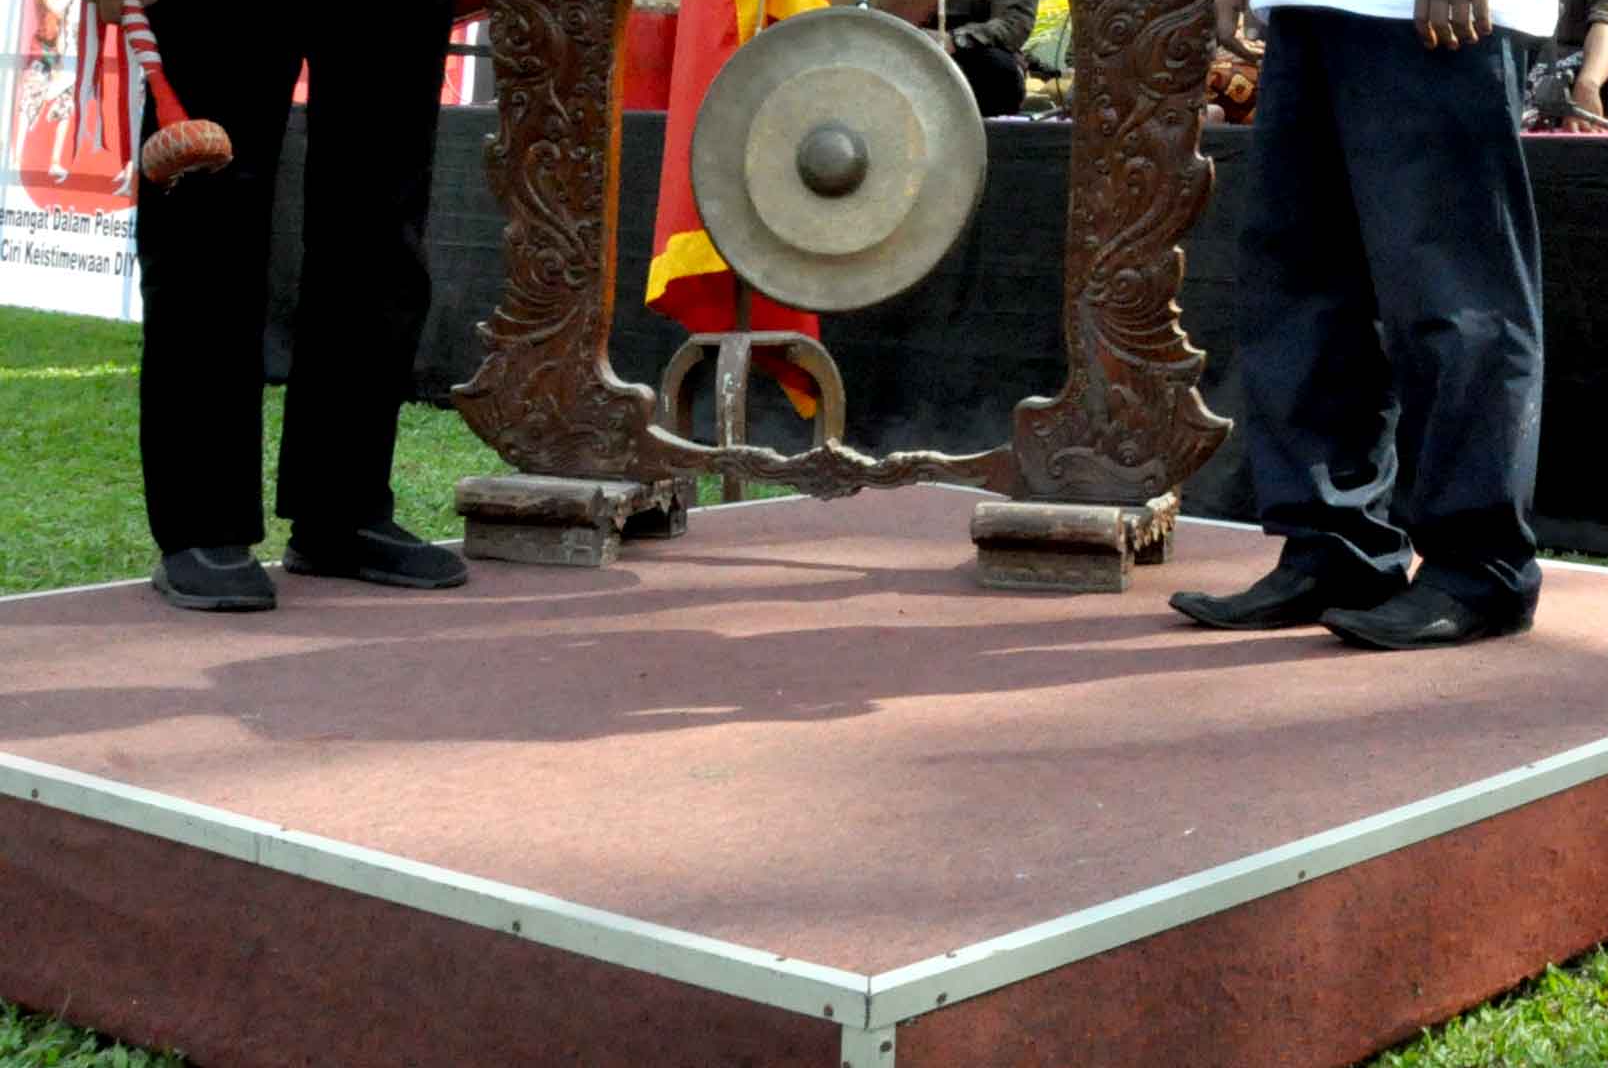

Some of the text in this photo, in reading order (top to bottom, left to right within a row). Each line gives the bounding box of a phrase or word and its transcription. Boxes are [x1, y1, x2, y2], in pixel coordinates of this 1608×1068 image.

[53, 206, 91, 235] Dalam
[1, 238, 21, 263] Ciri
[25, 239, 111, 275] Keistimewaan
